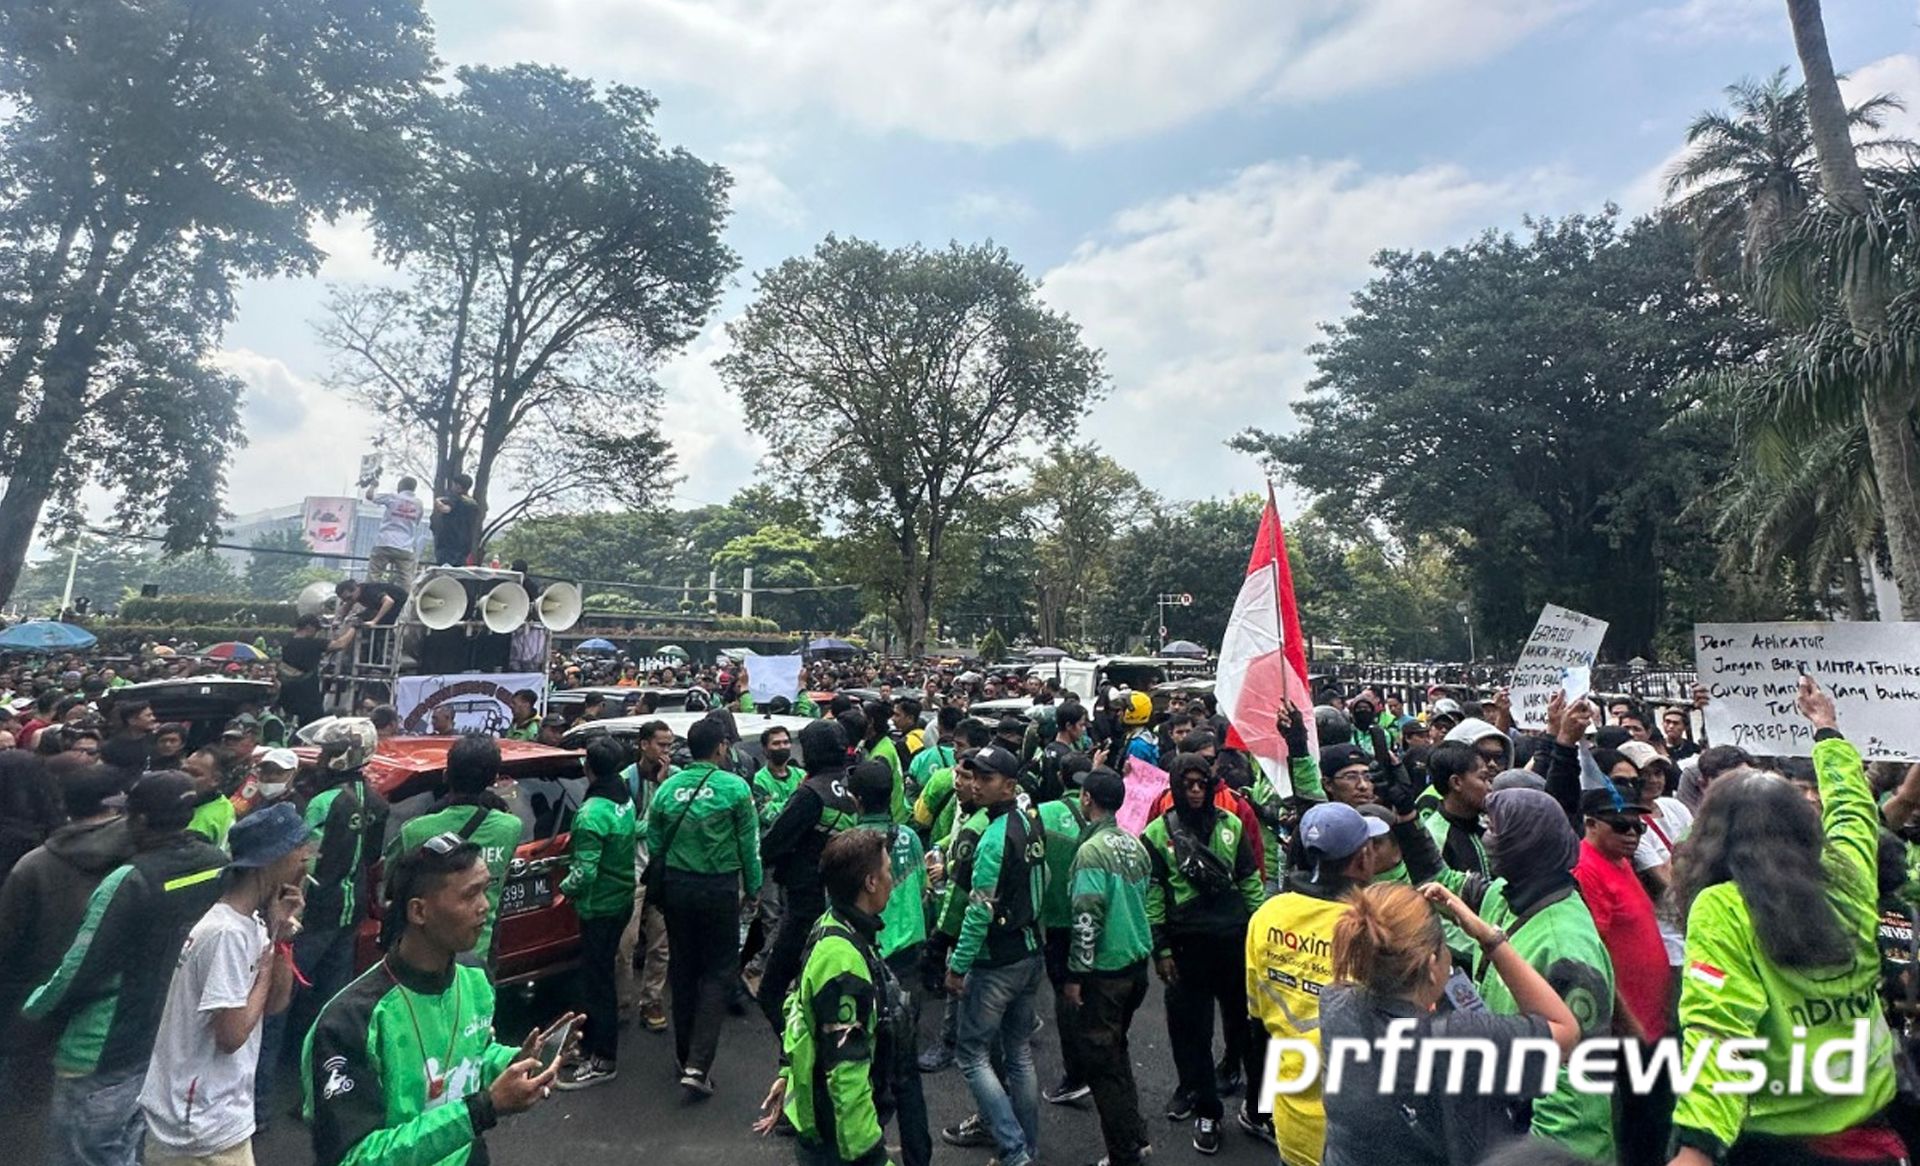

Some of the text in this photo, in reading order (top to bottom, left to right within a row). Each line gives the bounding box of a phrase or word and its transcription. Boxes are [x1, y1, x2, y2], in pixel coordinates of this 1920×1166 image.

[1700, 634, 1734, 651] Dear
[1712, 656, 1765, 676] Jangan
[1816, 659, 1866, 676] MITRA
[1825, 682, 1868, 701] Yang
[1073, 912, 1096, 966] Grab
